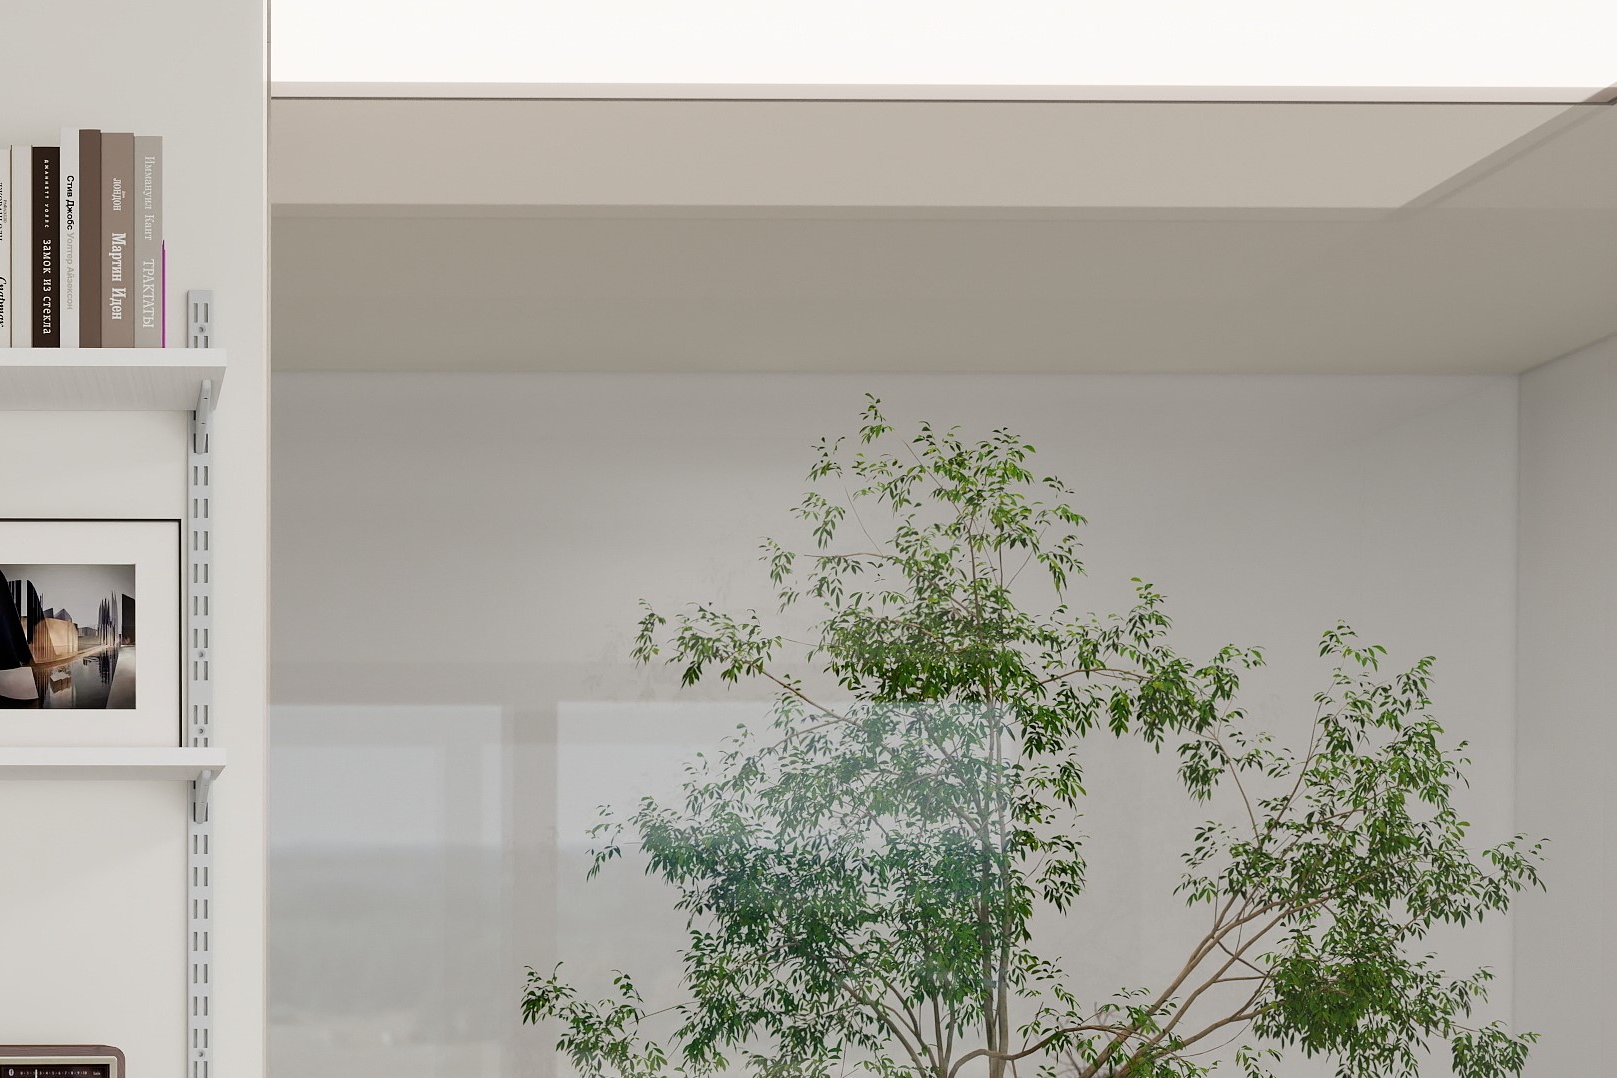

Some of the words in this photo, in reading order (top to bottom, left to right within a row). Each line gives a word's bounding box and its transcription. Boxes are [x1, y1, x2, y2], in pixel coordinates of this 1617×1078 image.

[111, 178, 122, 211] ЛОНДОН
[142, 156, 155, 209] Иммануил
[66, 200, 74, 230] Джобс
[144, 214, 154, 240] Кант
[65, 232, 74, 264] Уолтер
[109, 232, 126, 281] Мартин
[66, 267, 75, 310] Айзексон
[110, 288, 126, 320] Иден
[142, 259, 154, 328] ТРАКТАТЫ
